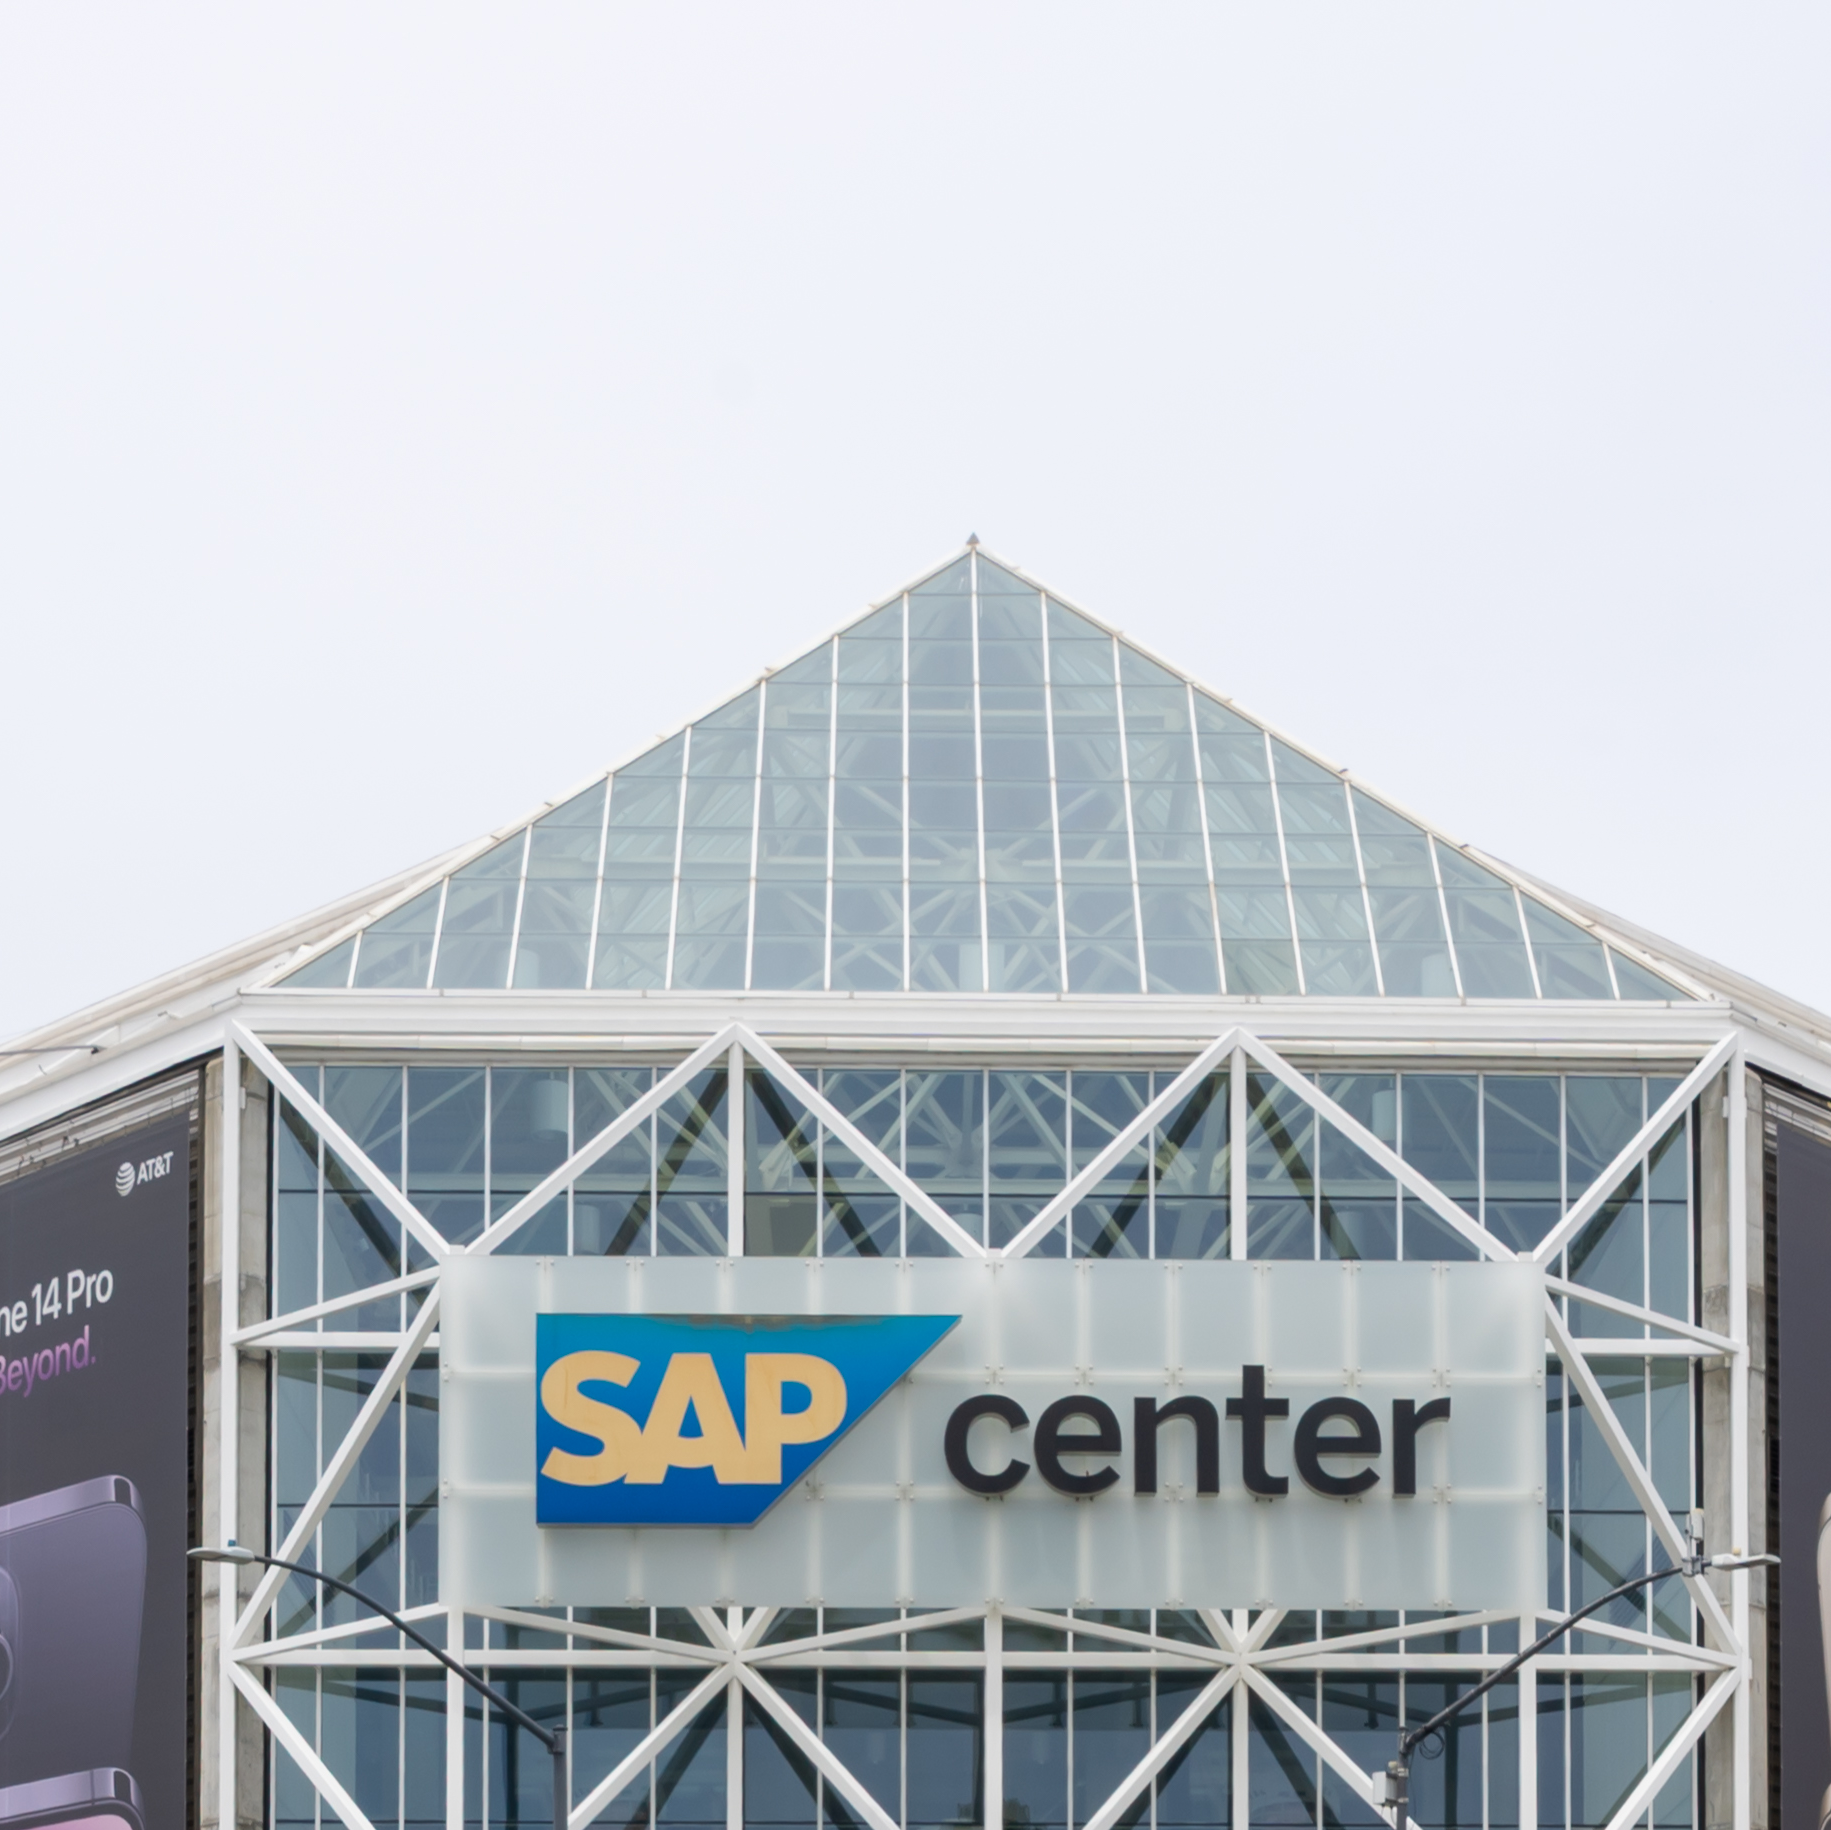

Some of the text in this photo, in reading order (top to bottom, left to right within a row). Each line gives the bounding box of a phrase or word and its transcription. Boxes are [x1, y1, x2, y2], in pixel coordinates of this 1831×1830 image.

[137, 1151, 173, 1184] AT&T
[32, 1277, 61, 1325] 14
[68, 1269, 113, 1314] Pro
[541, 1350, 1451, 1498] SAP center
